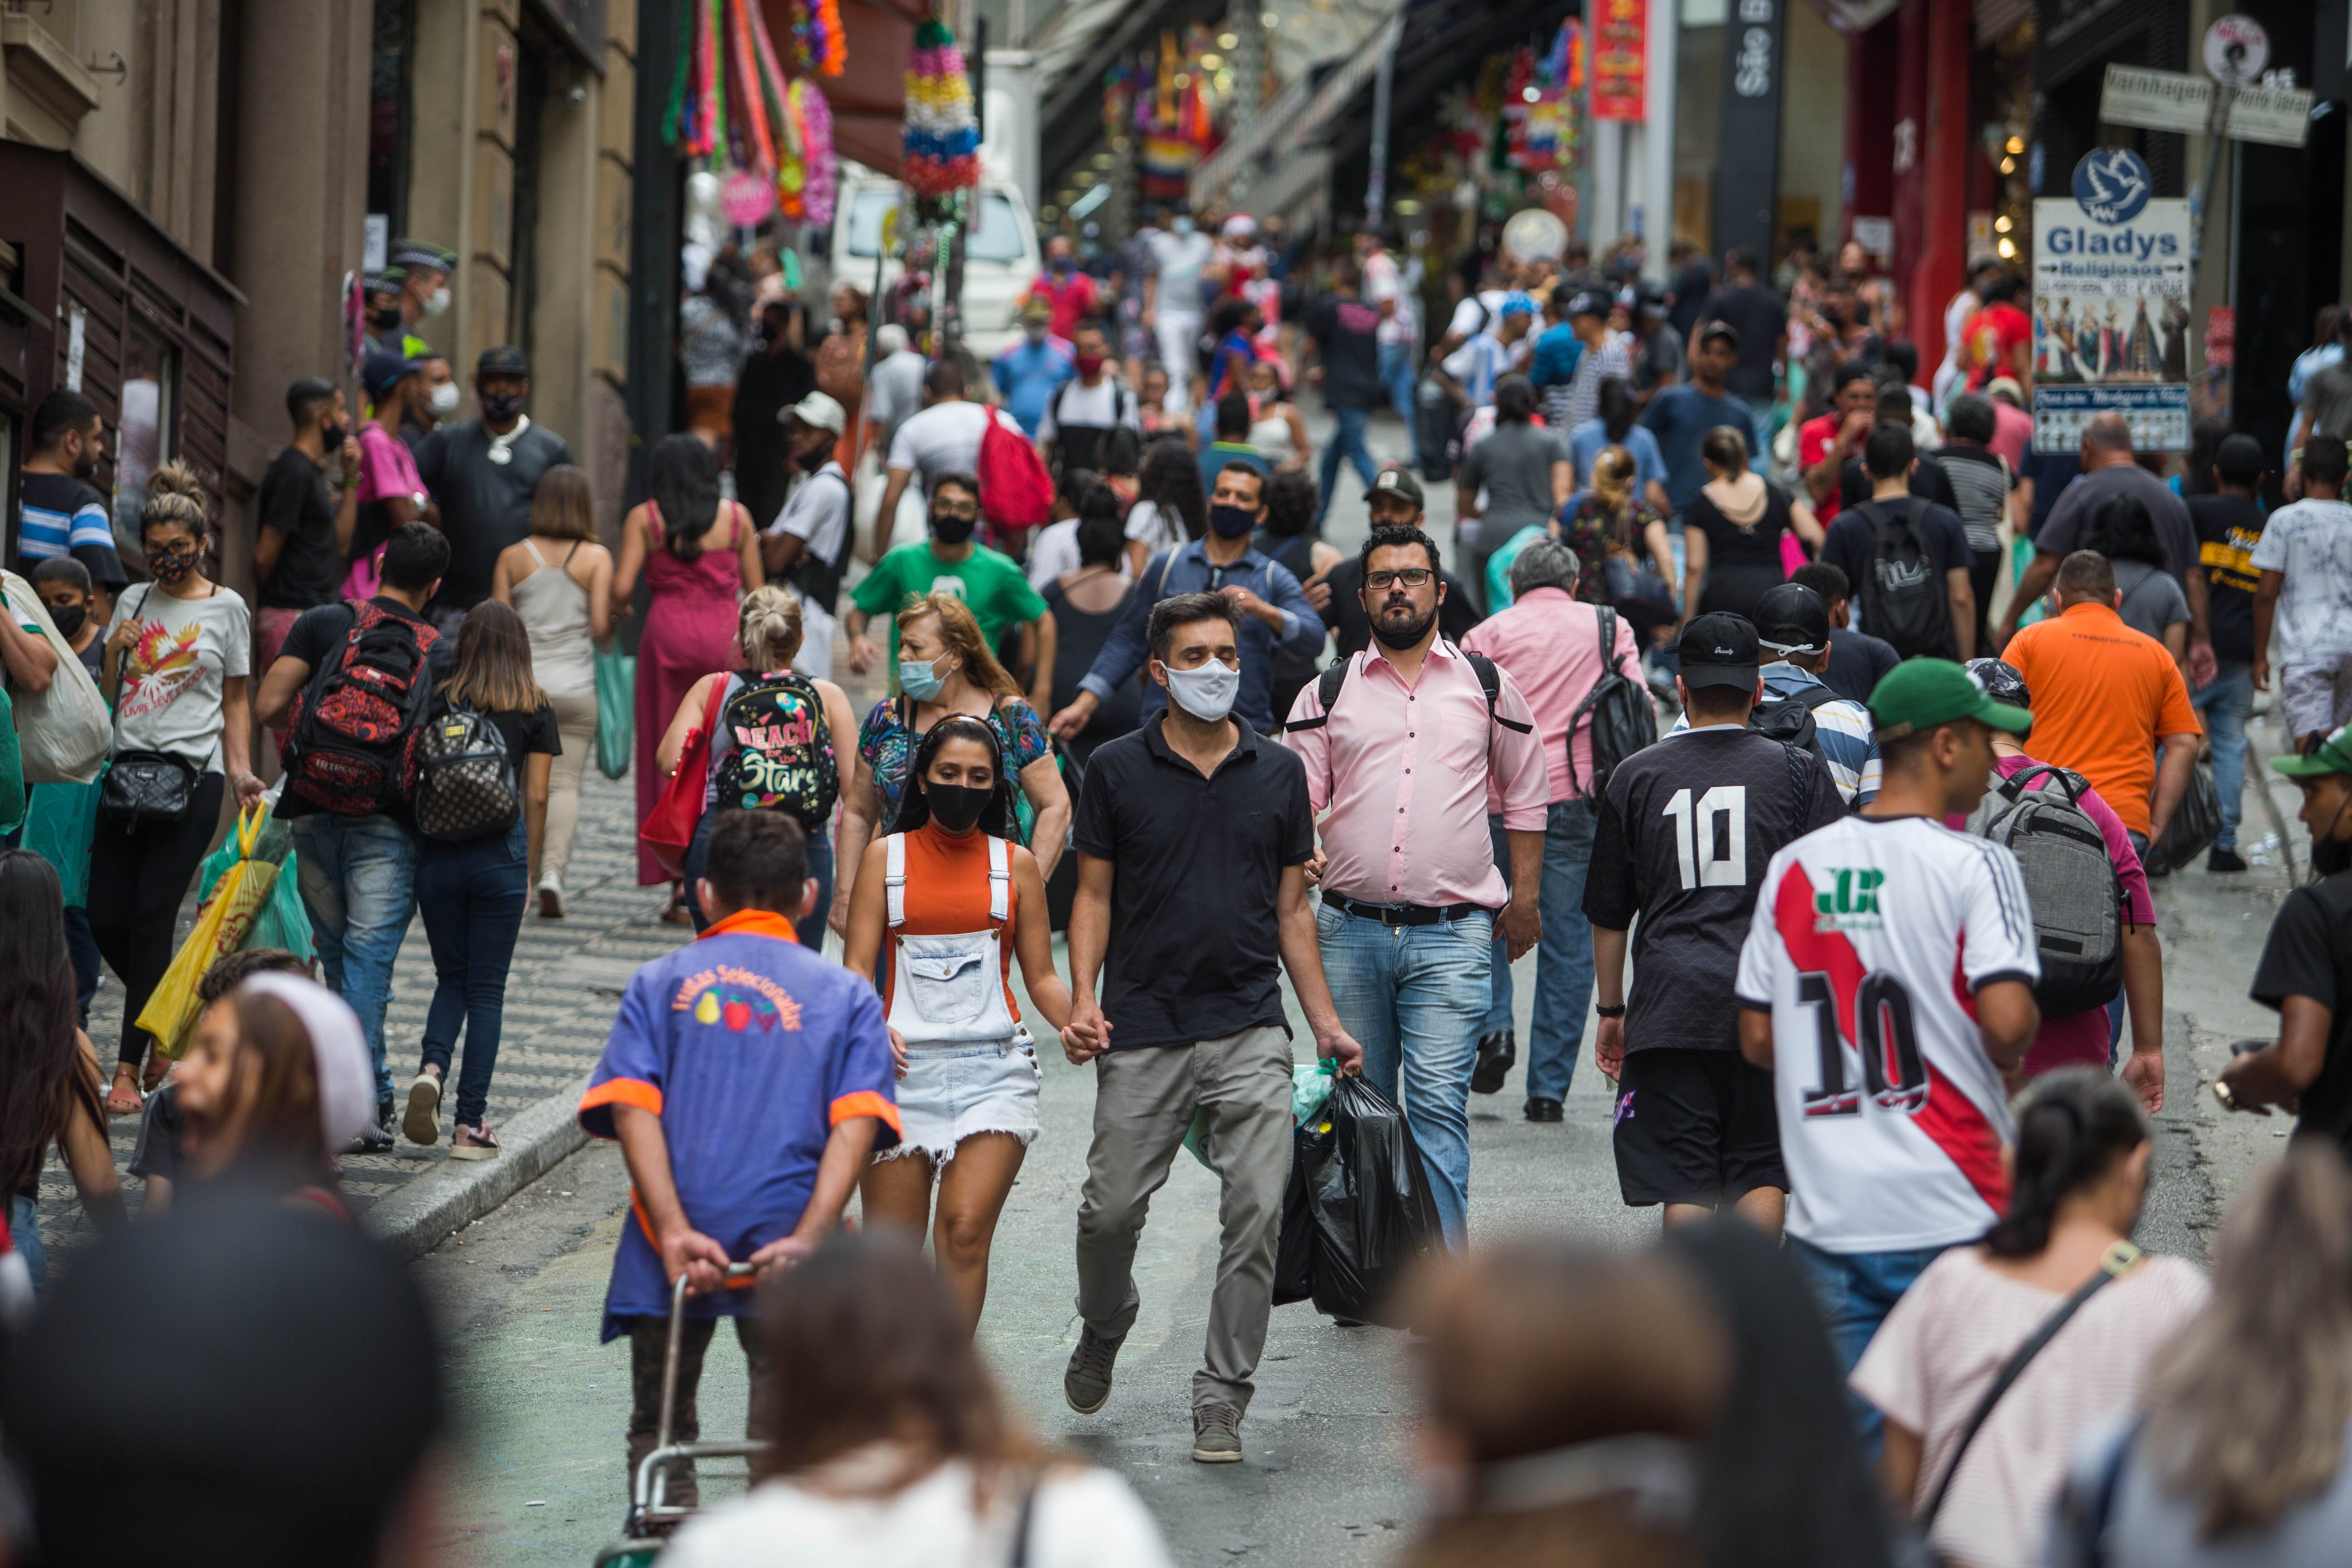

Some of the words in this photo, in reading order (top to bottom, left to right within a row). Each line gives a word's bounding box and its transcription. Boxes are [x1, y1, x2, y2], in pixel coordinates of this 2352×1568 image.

[1735, 27, 1772, 97] São
[2106, 68, 2209, 103] Varnhagen
[2233, 87, 2269, 108] Porto
[2273, 92, 2308, 112] Geral
[2048, 225, 2178, 262] Gladys
[2060, 260, 2163, 279] Religiosos
[153, 689, 174, 709] LEVE
[175, 686, 181, 696] E
[734, 719, 813, 750] REACH
[738, 752, 819, 793] Stars
[1662, 785, 1746, 890] 10
[716, 964, 803, 1031] Selecionadas
[1796, 968, 1931, 1120] 10
